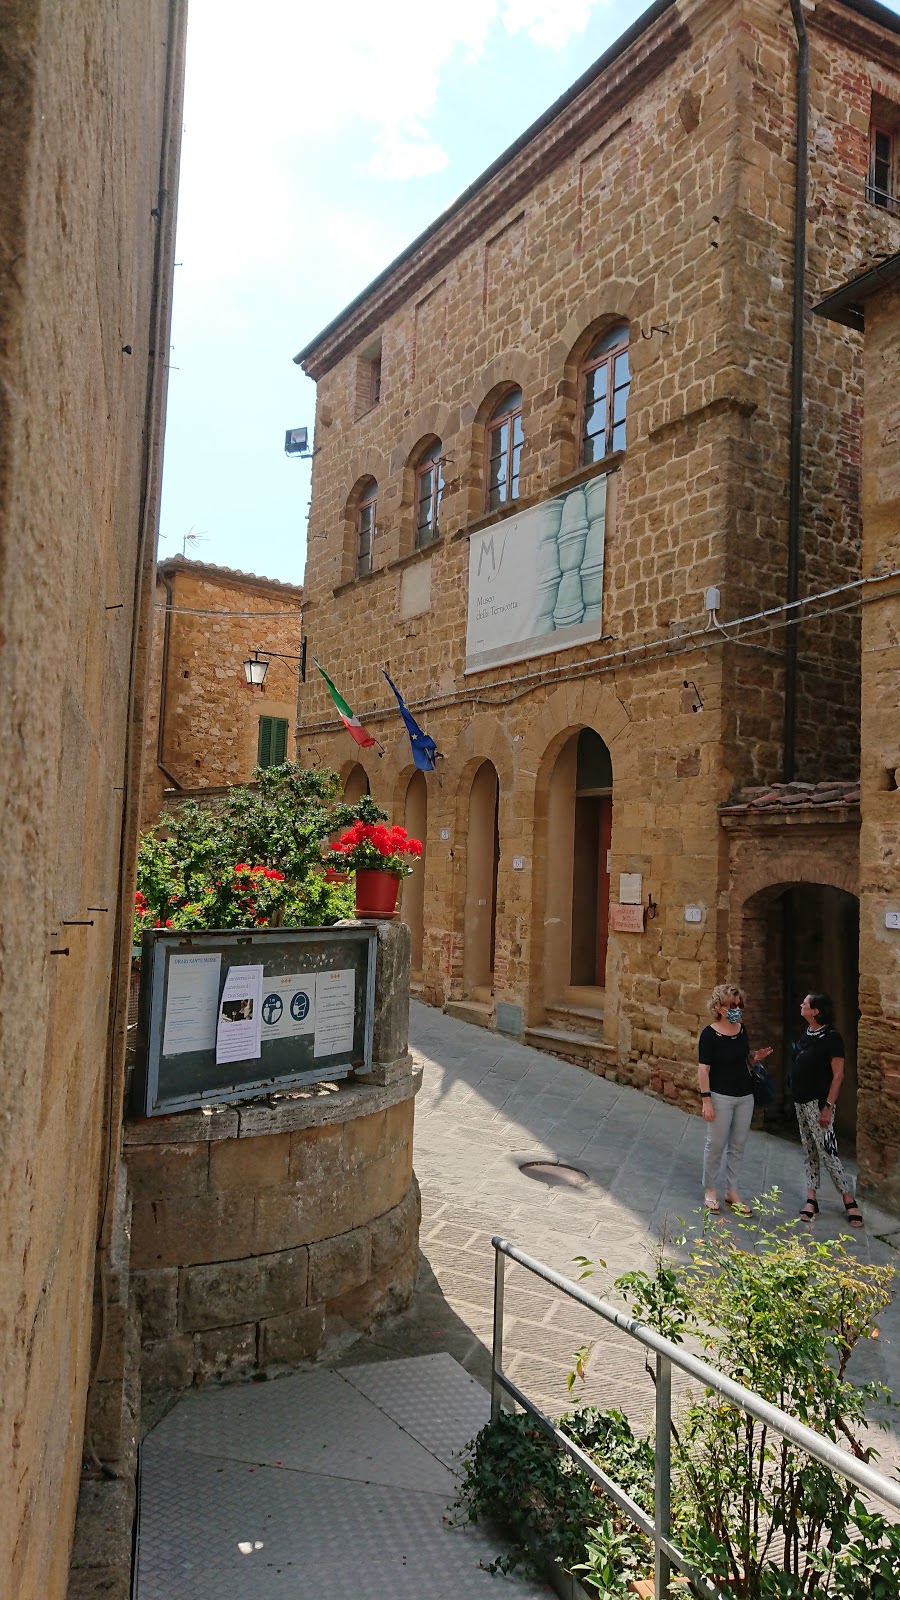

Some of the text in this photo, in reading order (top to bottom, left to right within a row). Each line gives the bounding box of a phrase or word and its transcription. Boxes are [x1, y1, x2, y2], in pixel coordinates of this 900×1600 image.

[476, 595, 495, 607] Museo
[490, 601, 518, 616] Terracotta
[891, 914, 898, 926] 2
